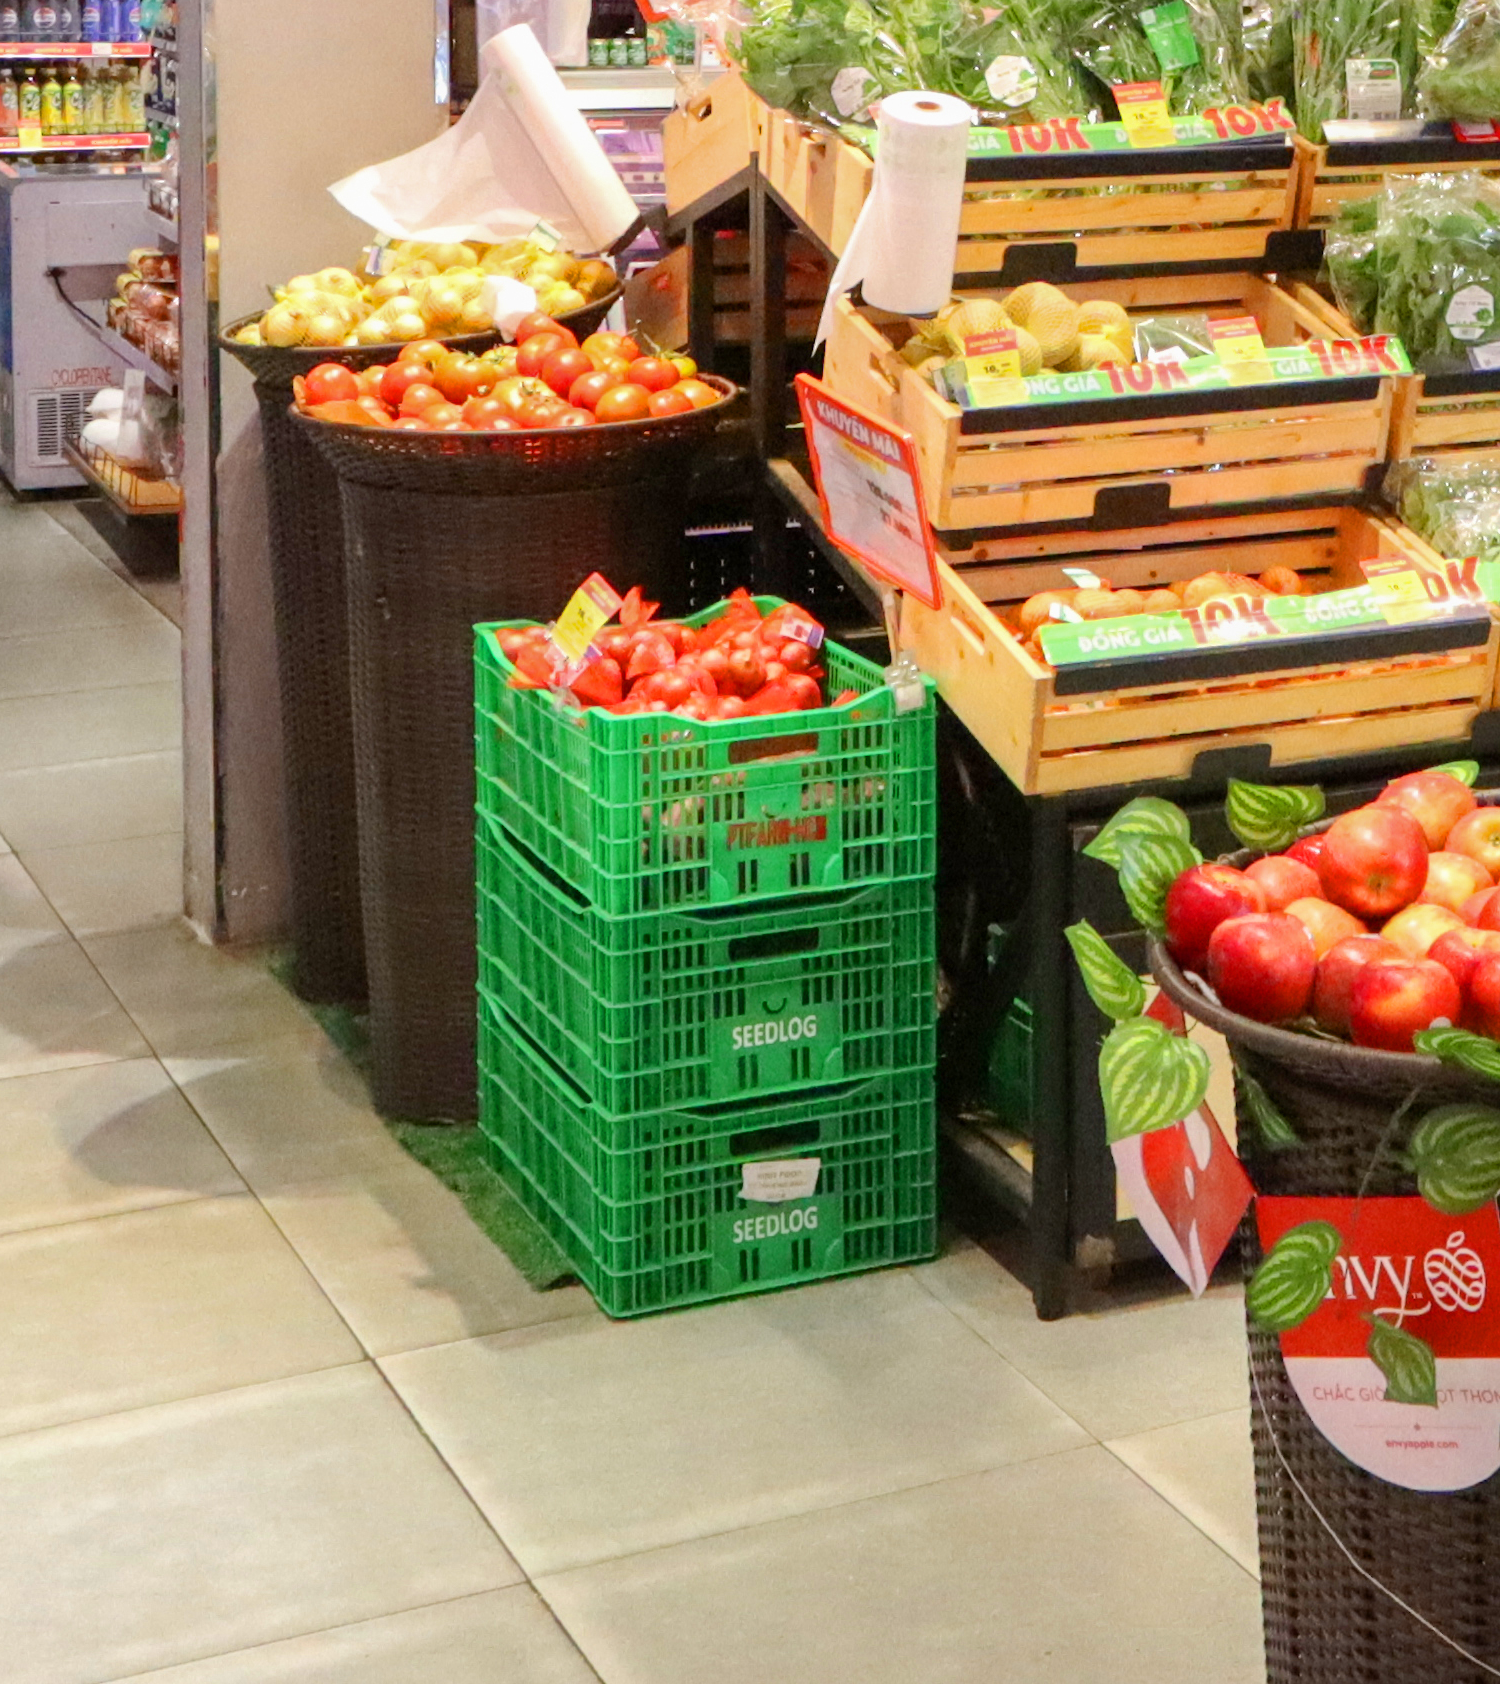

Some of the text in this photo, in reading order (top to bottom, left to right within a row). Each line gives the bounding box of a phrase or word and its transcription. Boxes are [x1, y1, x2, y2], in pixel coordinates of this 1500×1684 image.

[1006, 117, 1091, 154] 10K
[1202, 99, 1296, 140] 10K
[1308, 335, 1401, 378] 10K
[816, 399, 870, 448] KHUYẾN
[1078, 621, 1184, 654] ĐỒNG GIÁ
[732, 1015, 817, 1051] SEEDLOG
[733, 1206, 818, 1244] SEEDLOG
[1323, 1255, 1432, 1329] nvy
